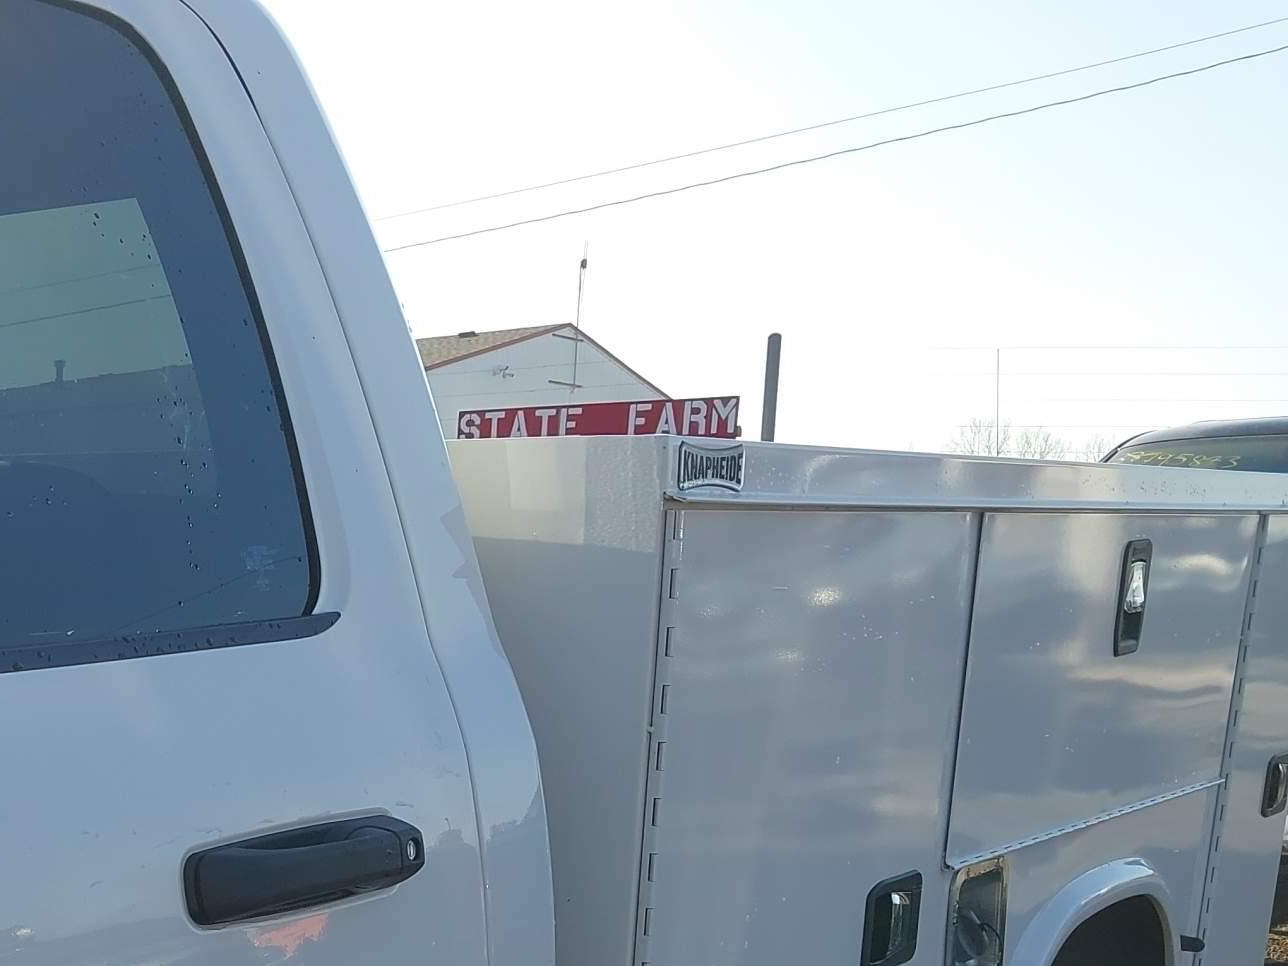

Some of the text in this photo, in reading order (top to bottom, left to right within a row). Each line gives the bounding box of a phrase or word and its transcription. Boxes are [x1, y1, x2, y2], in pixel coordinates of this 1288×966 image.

[460, 399, 737, 438] STATE FARM
[682, 449, 744, 485] KNAPHEIDE
